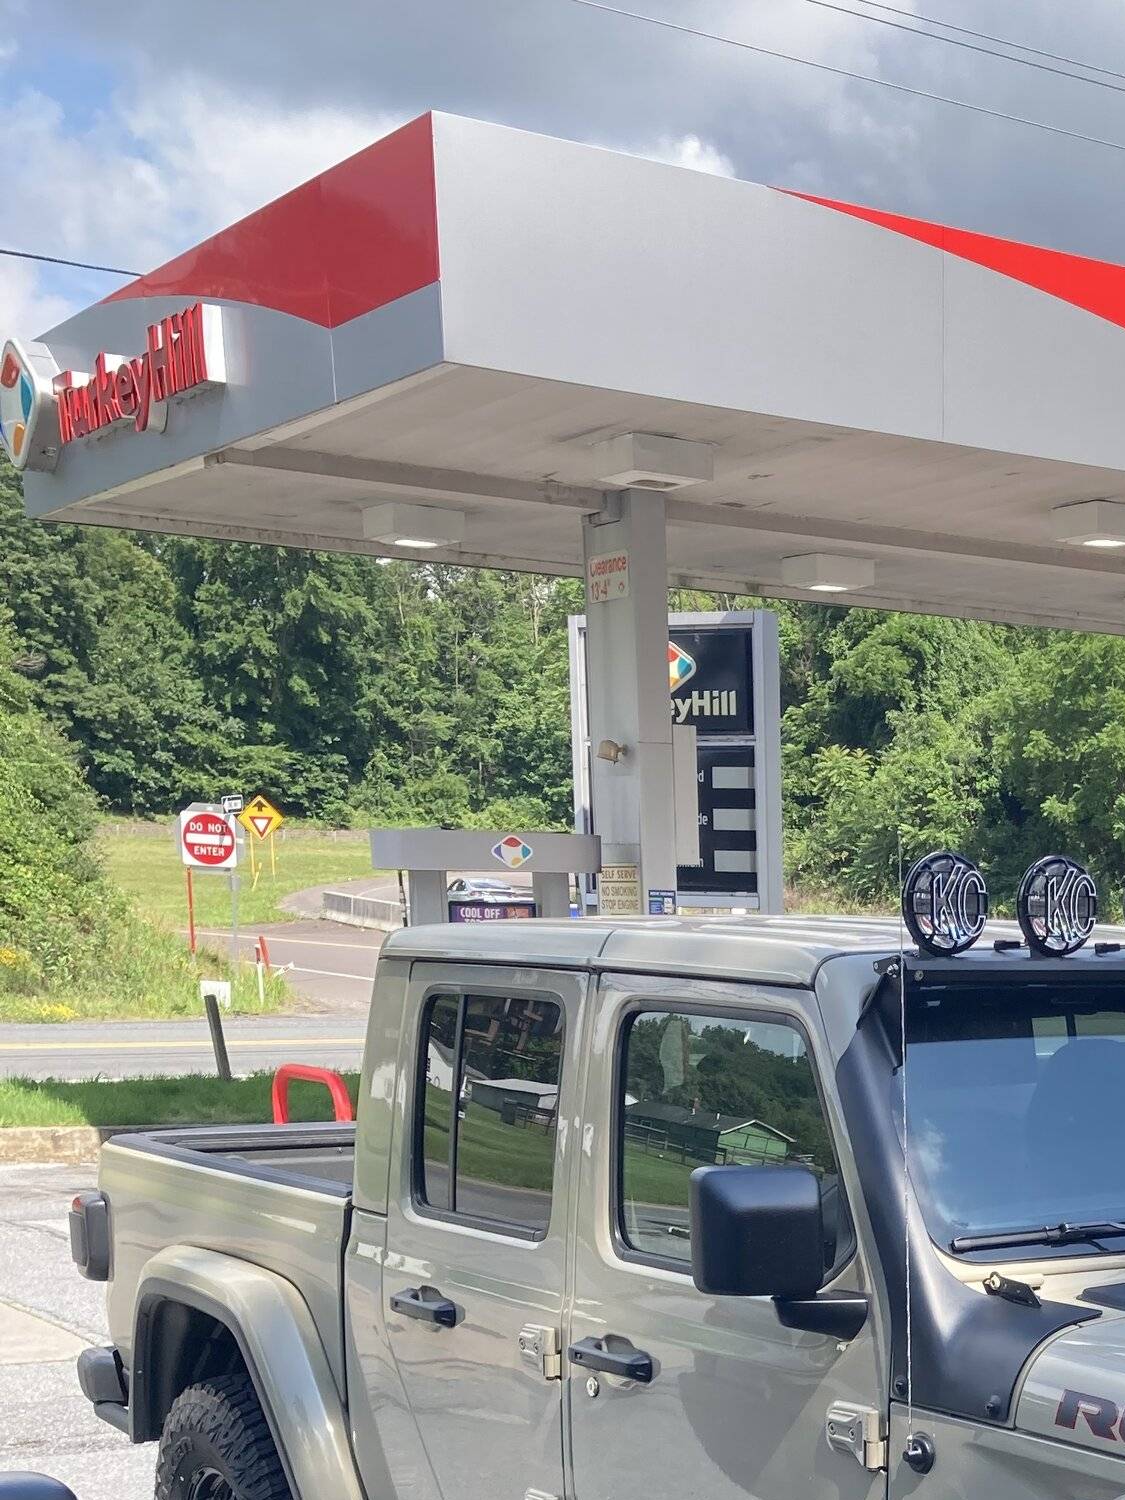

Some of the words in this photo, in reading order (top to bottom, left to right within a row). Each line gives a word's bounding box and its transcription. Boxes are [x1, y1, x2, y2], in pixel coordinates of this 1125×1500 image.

[190, 822, 203, 832] DO
[208, 823, 228, 833] NOT
[194, 846, 225, 857] ENTER
[933, 865, 986, 942] KC
[1048, 869, 1096, 942] KC
[460, 907, 482, 918] COOL
[484, 907, 501, 919] OFF
